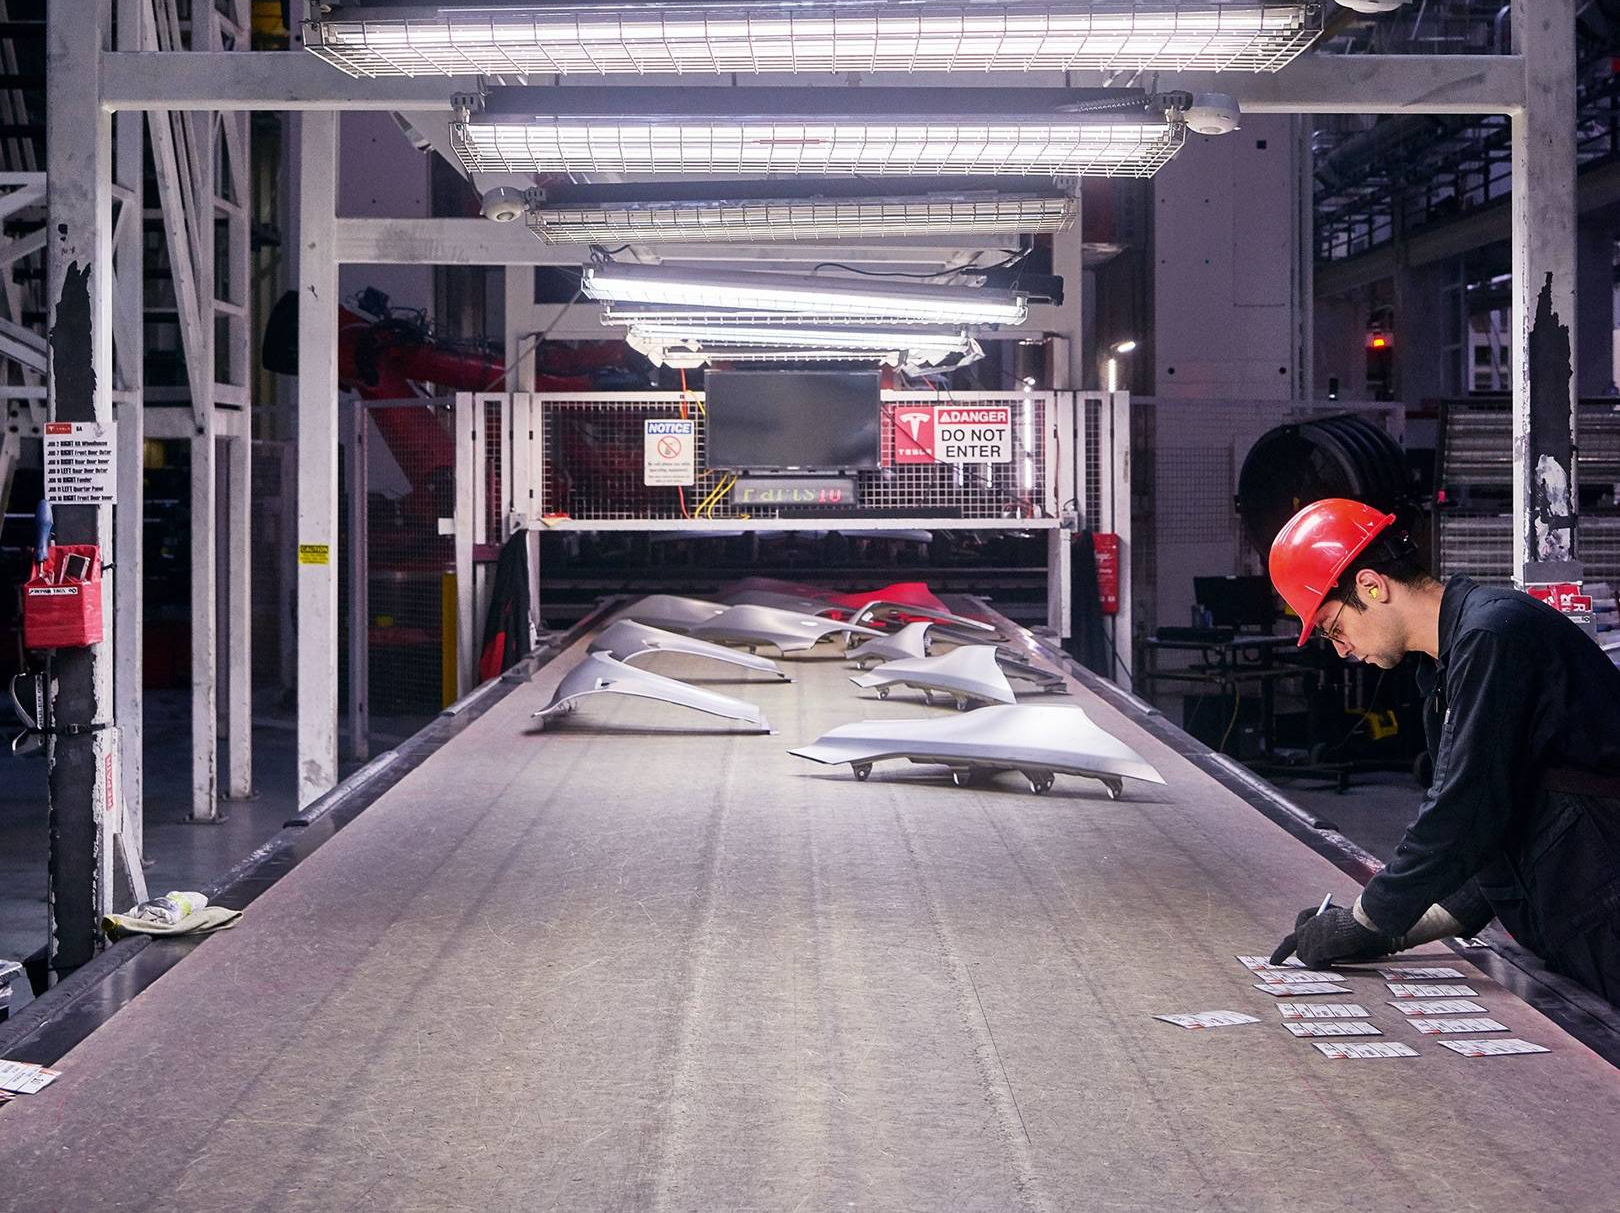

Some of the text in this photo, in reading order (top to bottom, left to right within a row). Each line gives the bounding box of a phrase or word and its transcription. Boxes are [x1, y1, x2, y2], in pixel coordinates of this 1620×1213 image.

[951, 411, 1006, 422] DANGER
[649, 424, 690, 433] NOTICE
[942, 429, 1006, 441] DO NOT
[946, 445, 1001, 457] ENTER
